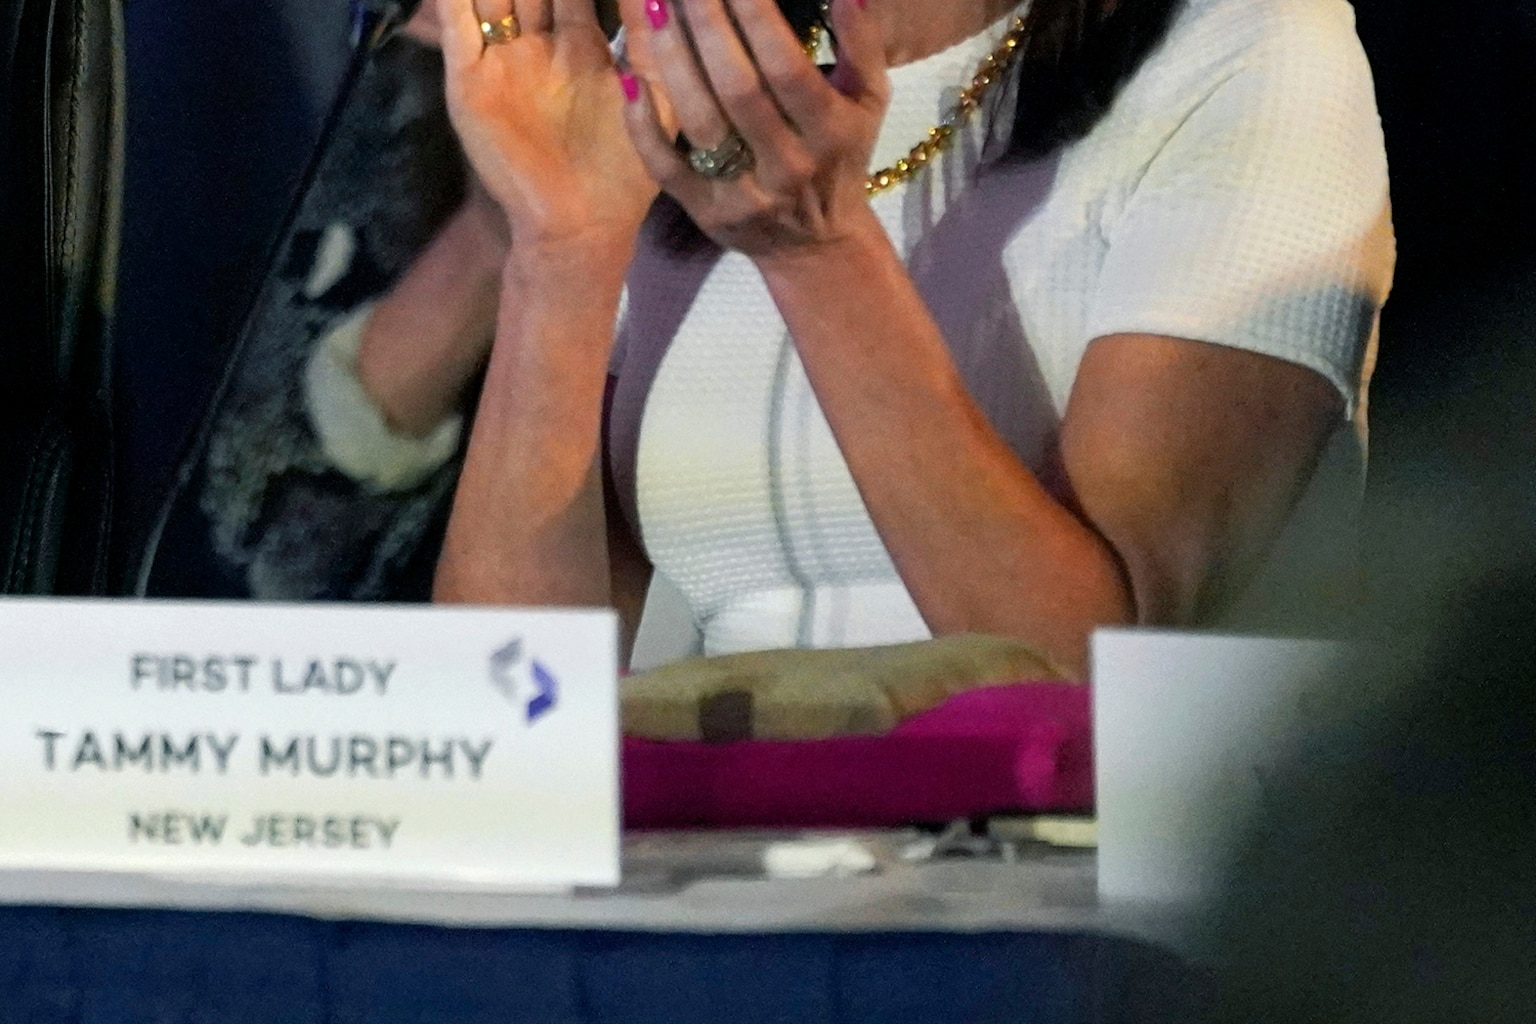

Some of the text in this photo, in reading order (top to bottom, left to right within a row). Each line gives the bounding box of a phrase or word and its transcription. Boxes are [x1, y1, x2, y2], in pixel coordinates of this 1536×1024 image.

[130, 652, 398, 696] FIRST LADY
[35, 728, 494, 780] TAMMY MURPHY
[129, 812, 401, 851] NEW JERSEY
